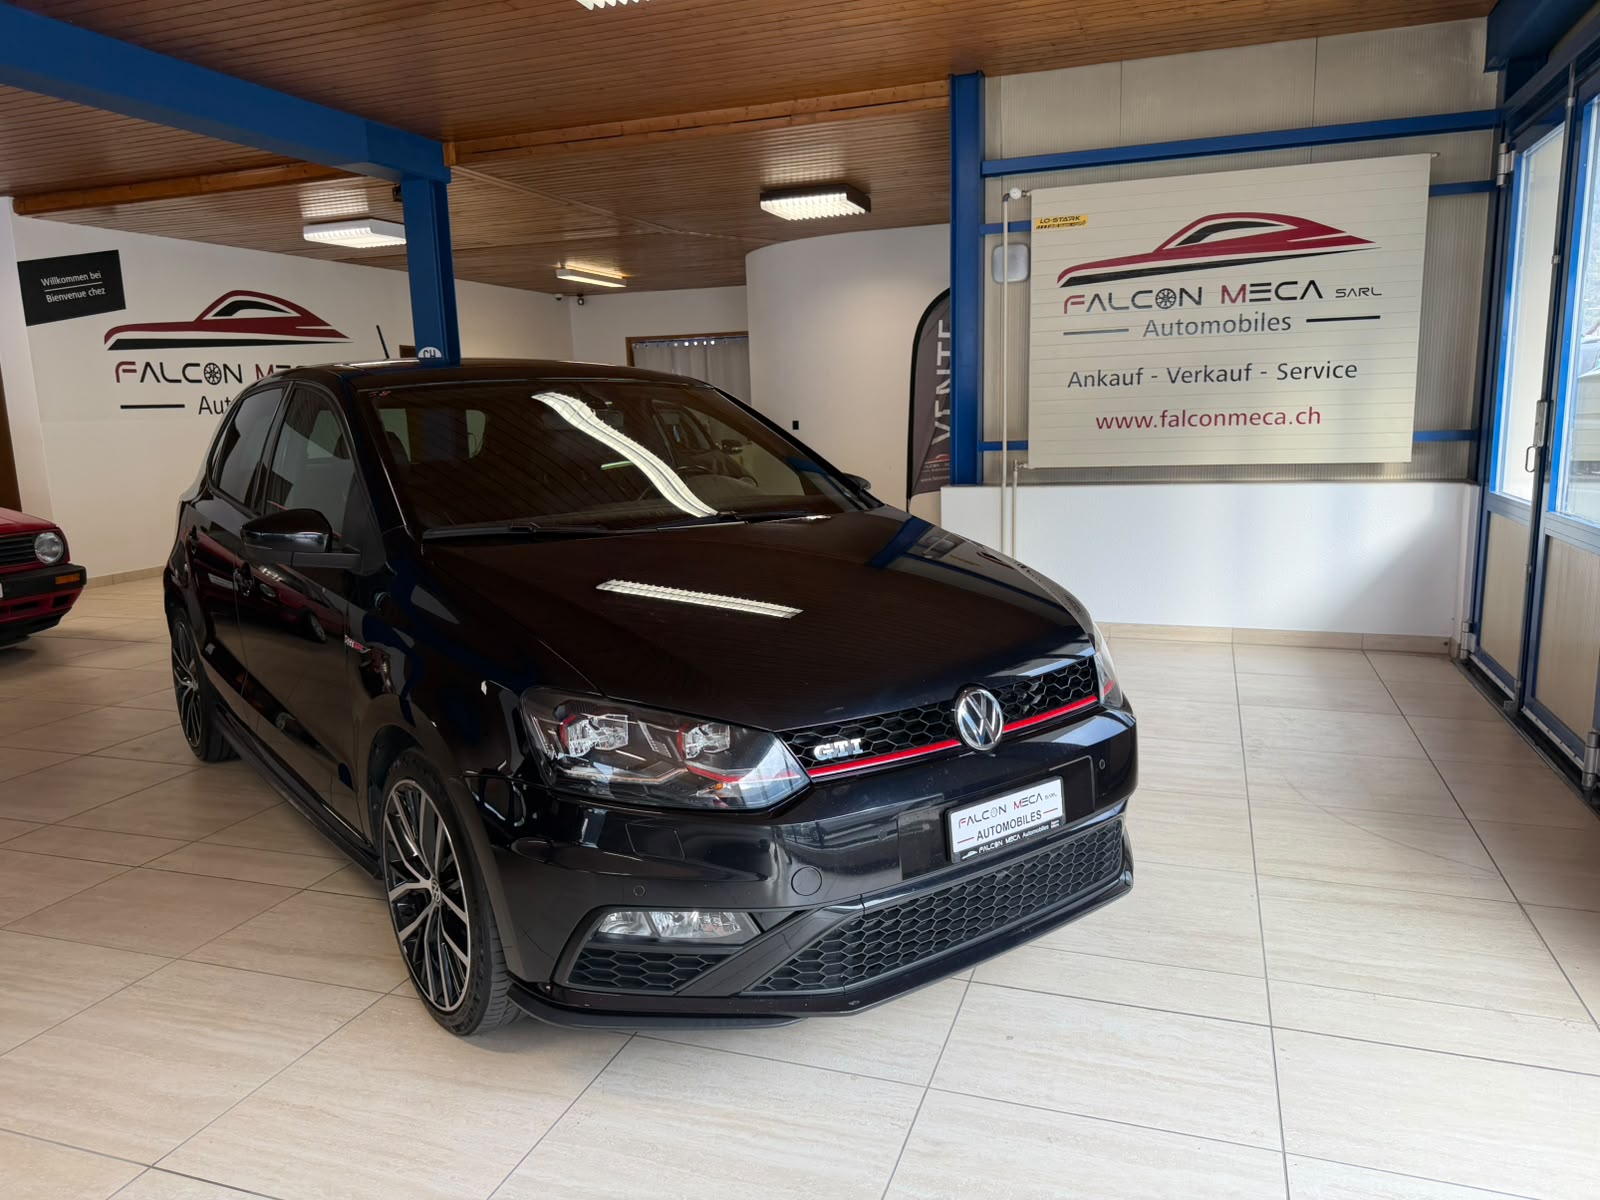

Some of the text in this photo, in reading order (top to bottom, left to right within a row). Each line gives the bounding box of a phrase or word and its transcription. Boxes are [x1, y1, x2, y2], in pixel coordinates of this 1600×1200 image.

[40, 270, 102, 287] Willkommen bei
[45, 287, 106, 303] Bienvenue chez
[1063, 280, 1383, 315] FALCON MECA SARL
[1142, 310, 1292, 338] Automobiles
[115, 361, 244, 386] FALCON
[1067, 367, 1145, 389] Ankauf
[1166, 362, 1253, 385] Verkauf
[1276, 360, 1358, 381] Service
[1095, 406, 1322, 430] www.falconmeca.ch
[813, 738, 864, 761] GTI
[958, 803, 1008, 829] FALCON
[1013, 792, 1043, 811] MECA
[976, 808, 1043, 842] AUTOMOBILES
[1021, 823, 1050, 839] Automobiles
